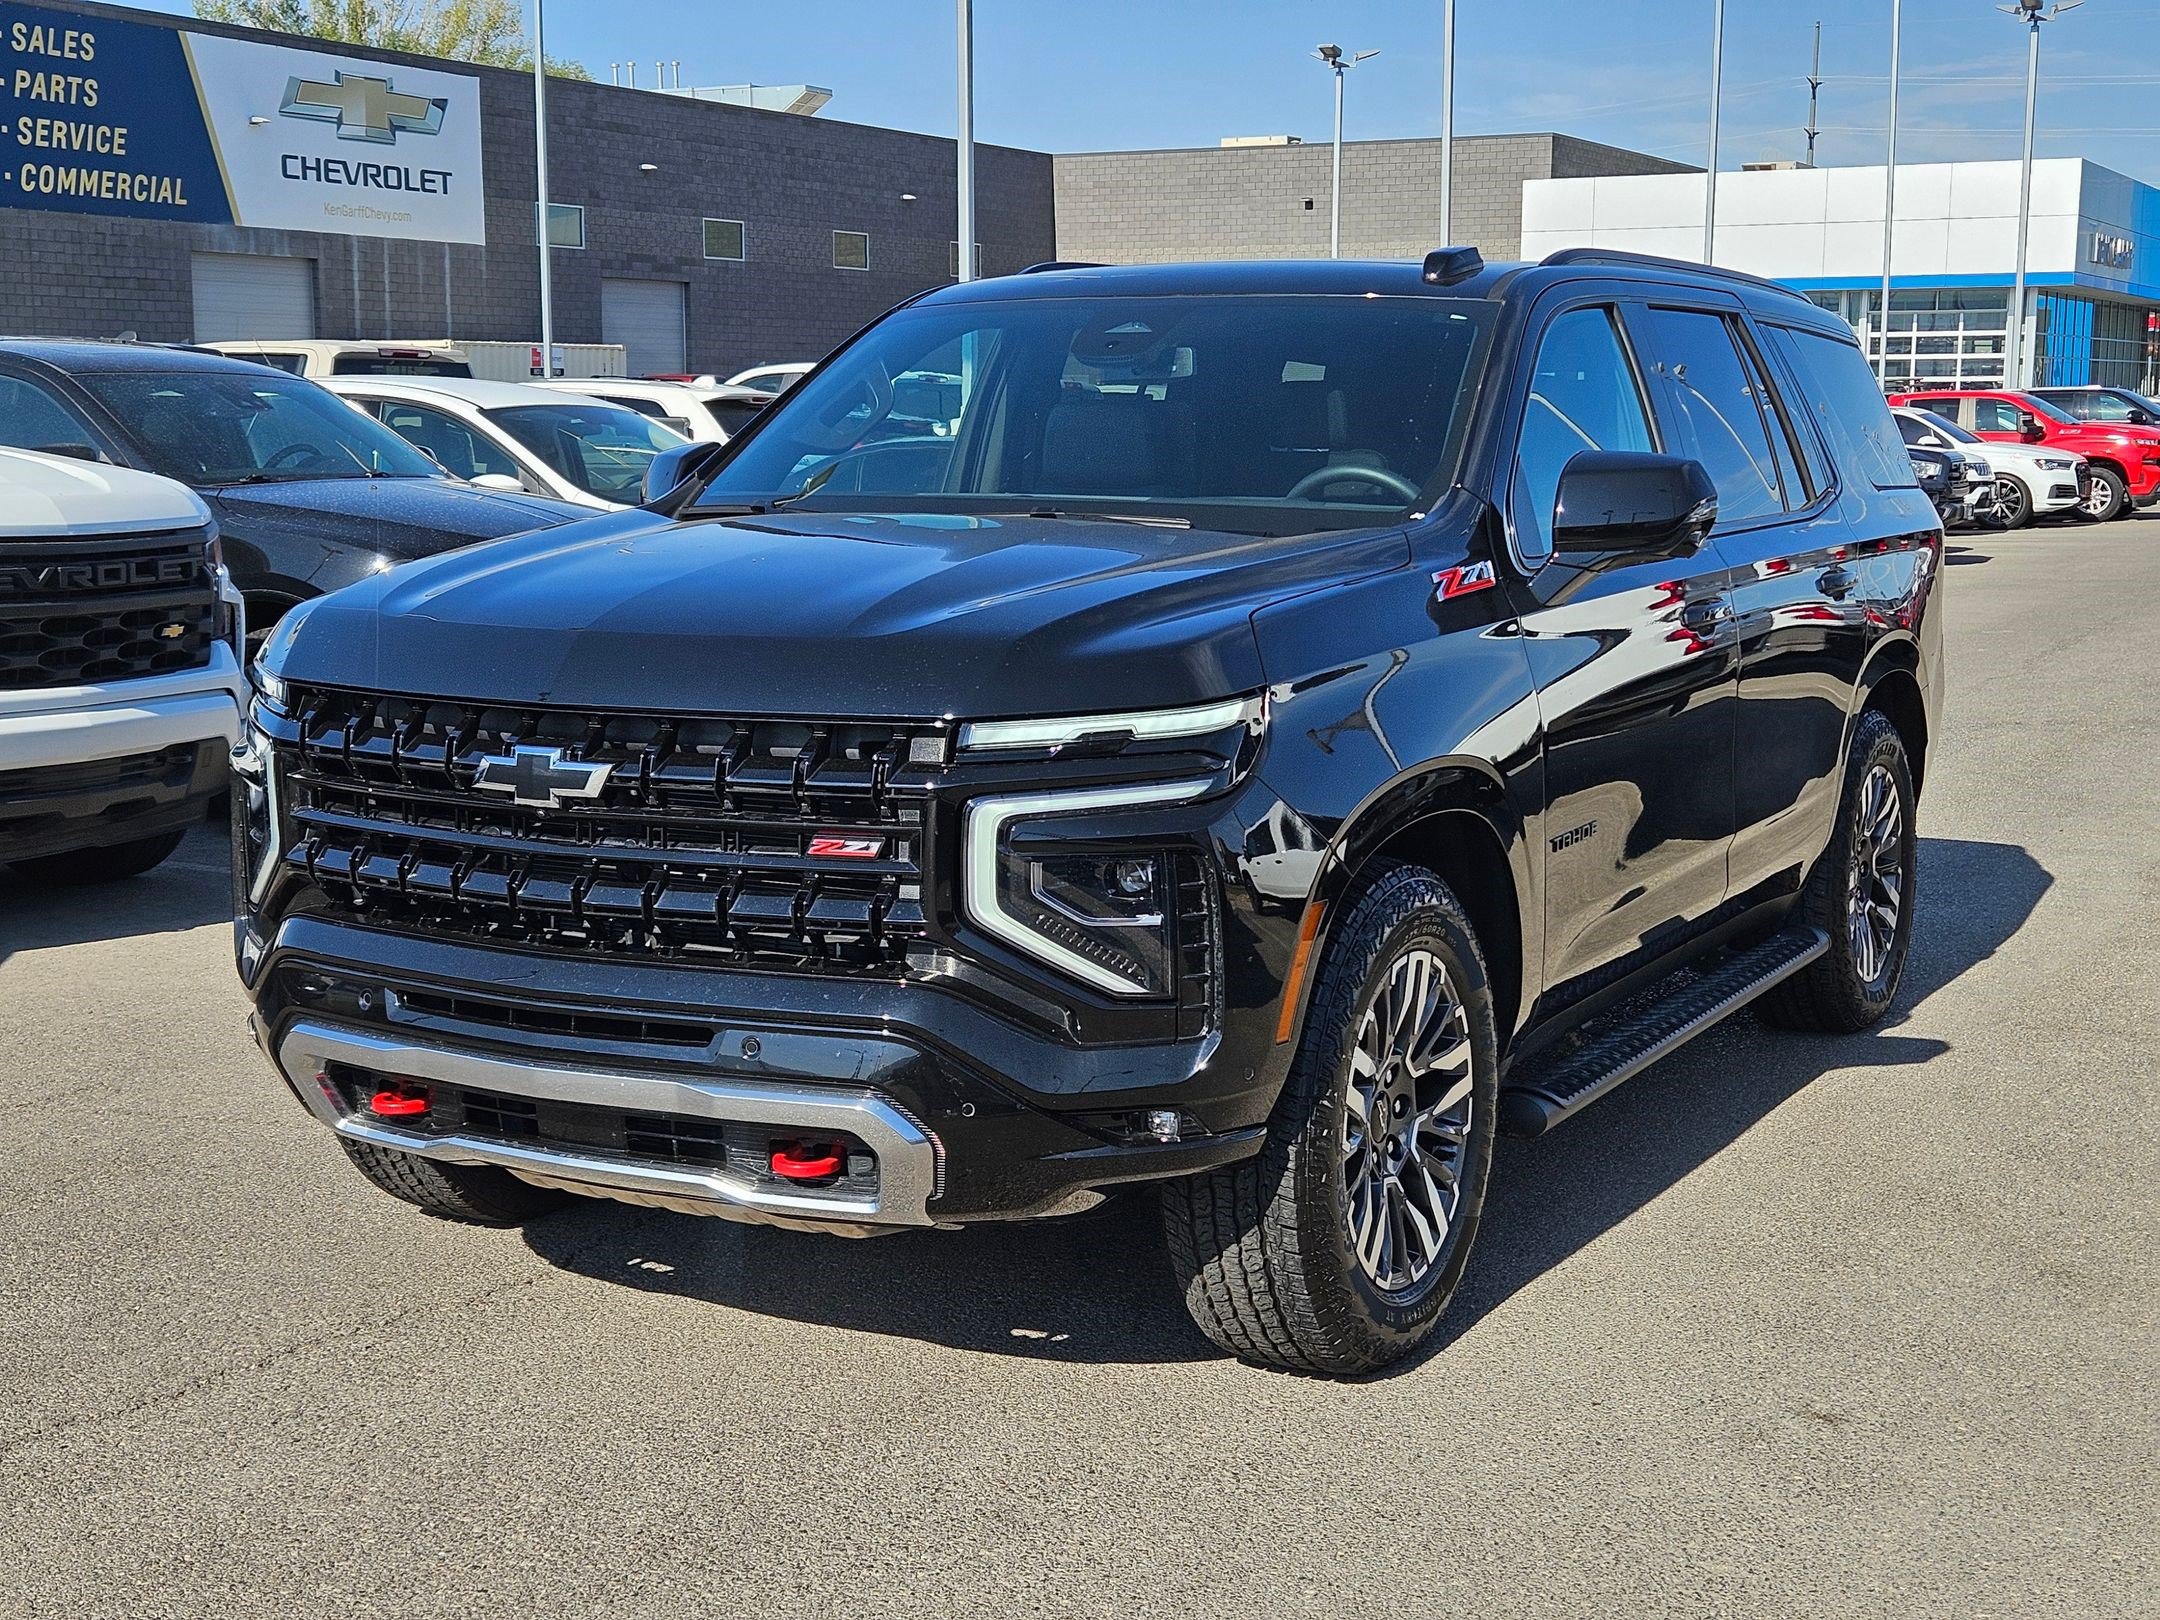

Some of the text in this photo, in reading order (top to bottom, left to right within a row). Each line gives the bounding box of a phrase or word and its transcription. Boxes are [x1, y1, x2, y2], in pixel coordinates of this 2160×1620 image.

[11, 22, 95, 61] SALES
[14, 69, 98, 107] PARTS
[17, 116, 128, 156] SERVICE
[21, 163, 188, 206] COMMERCIAL
[281, 153, 453, 195] CHEVROLET
[323, 201, 412, 223] KenGarffChevy.com
[1431, 560, 1496, 602] Z71
[807, 838, 882, 858] Z71
[1549, 820, 1598, 853] TAHOE
